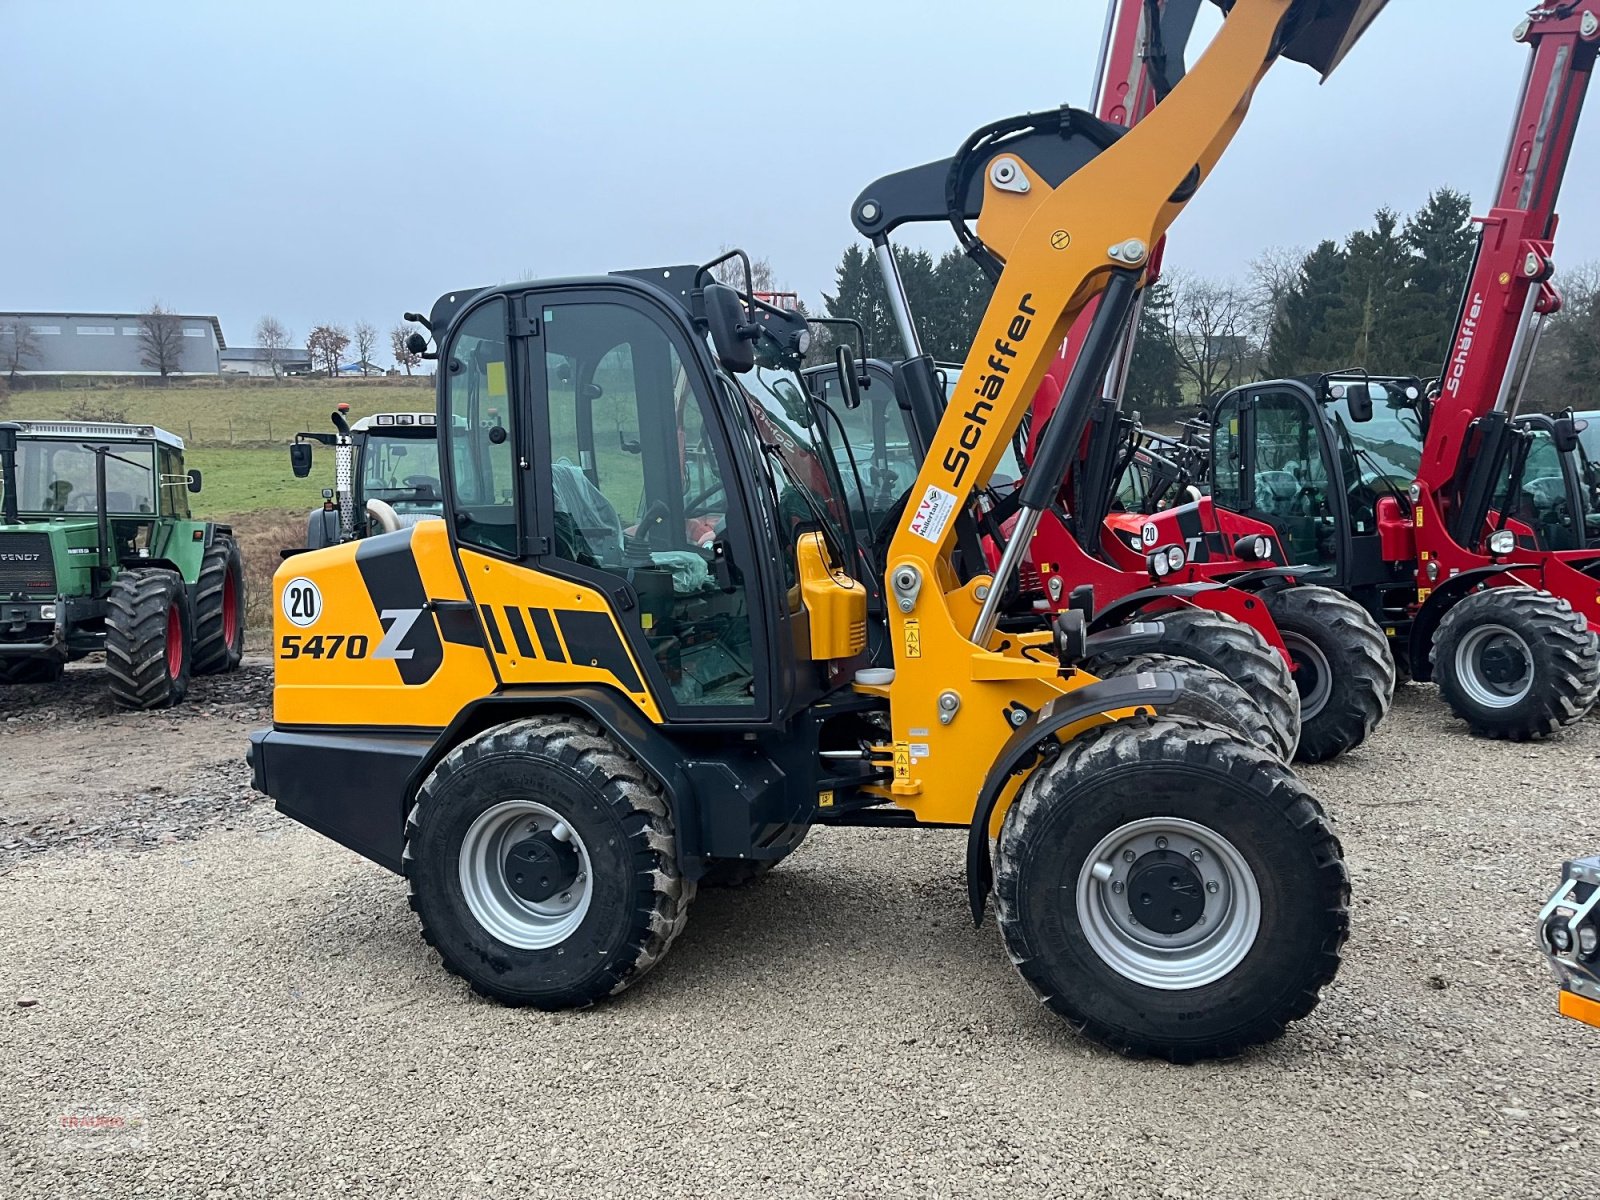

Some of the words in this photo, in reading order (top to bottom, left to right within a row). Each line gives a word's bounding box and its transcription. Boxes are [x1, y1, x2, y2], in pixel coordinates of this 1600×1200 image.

[1446, 292, 1483, 399] Schäffer
[942, 292, 1036, 488] Schäffer
[919, 502, 939, 538] Hallertau
[1144, 527, 1155, 542] 20
[0, 553, 40, 561] FENDT
[290, 587, 315, 618] 20
[280, 635, 369, 660] 5470
[371, 608, 423, 660] Z
